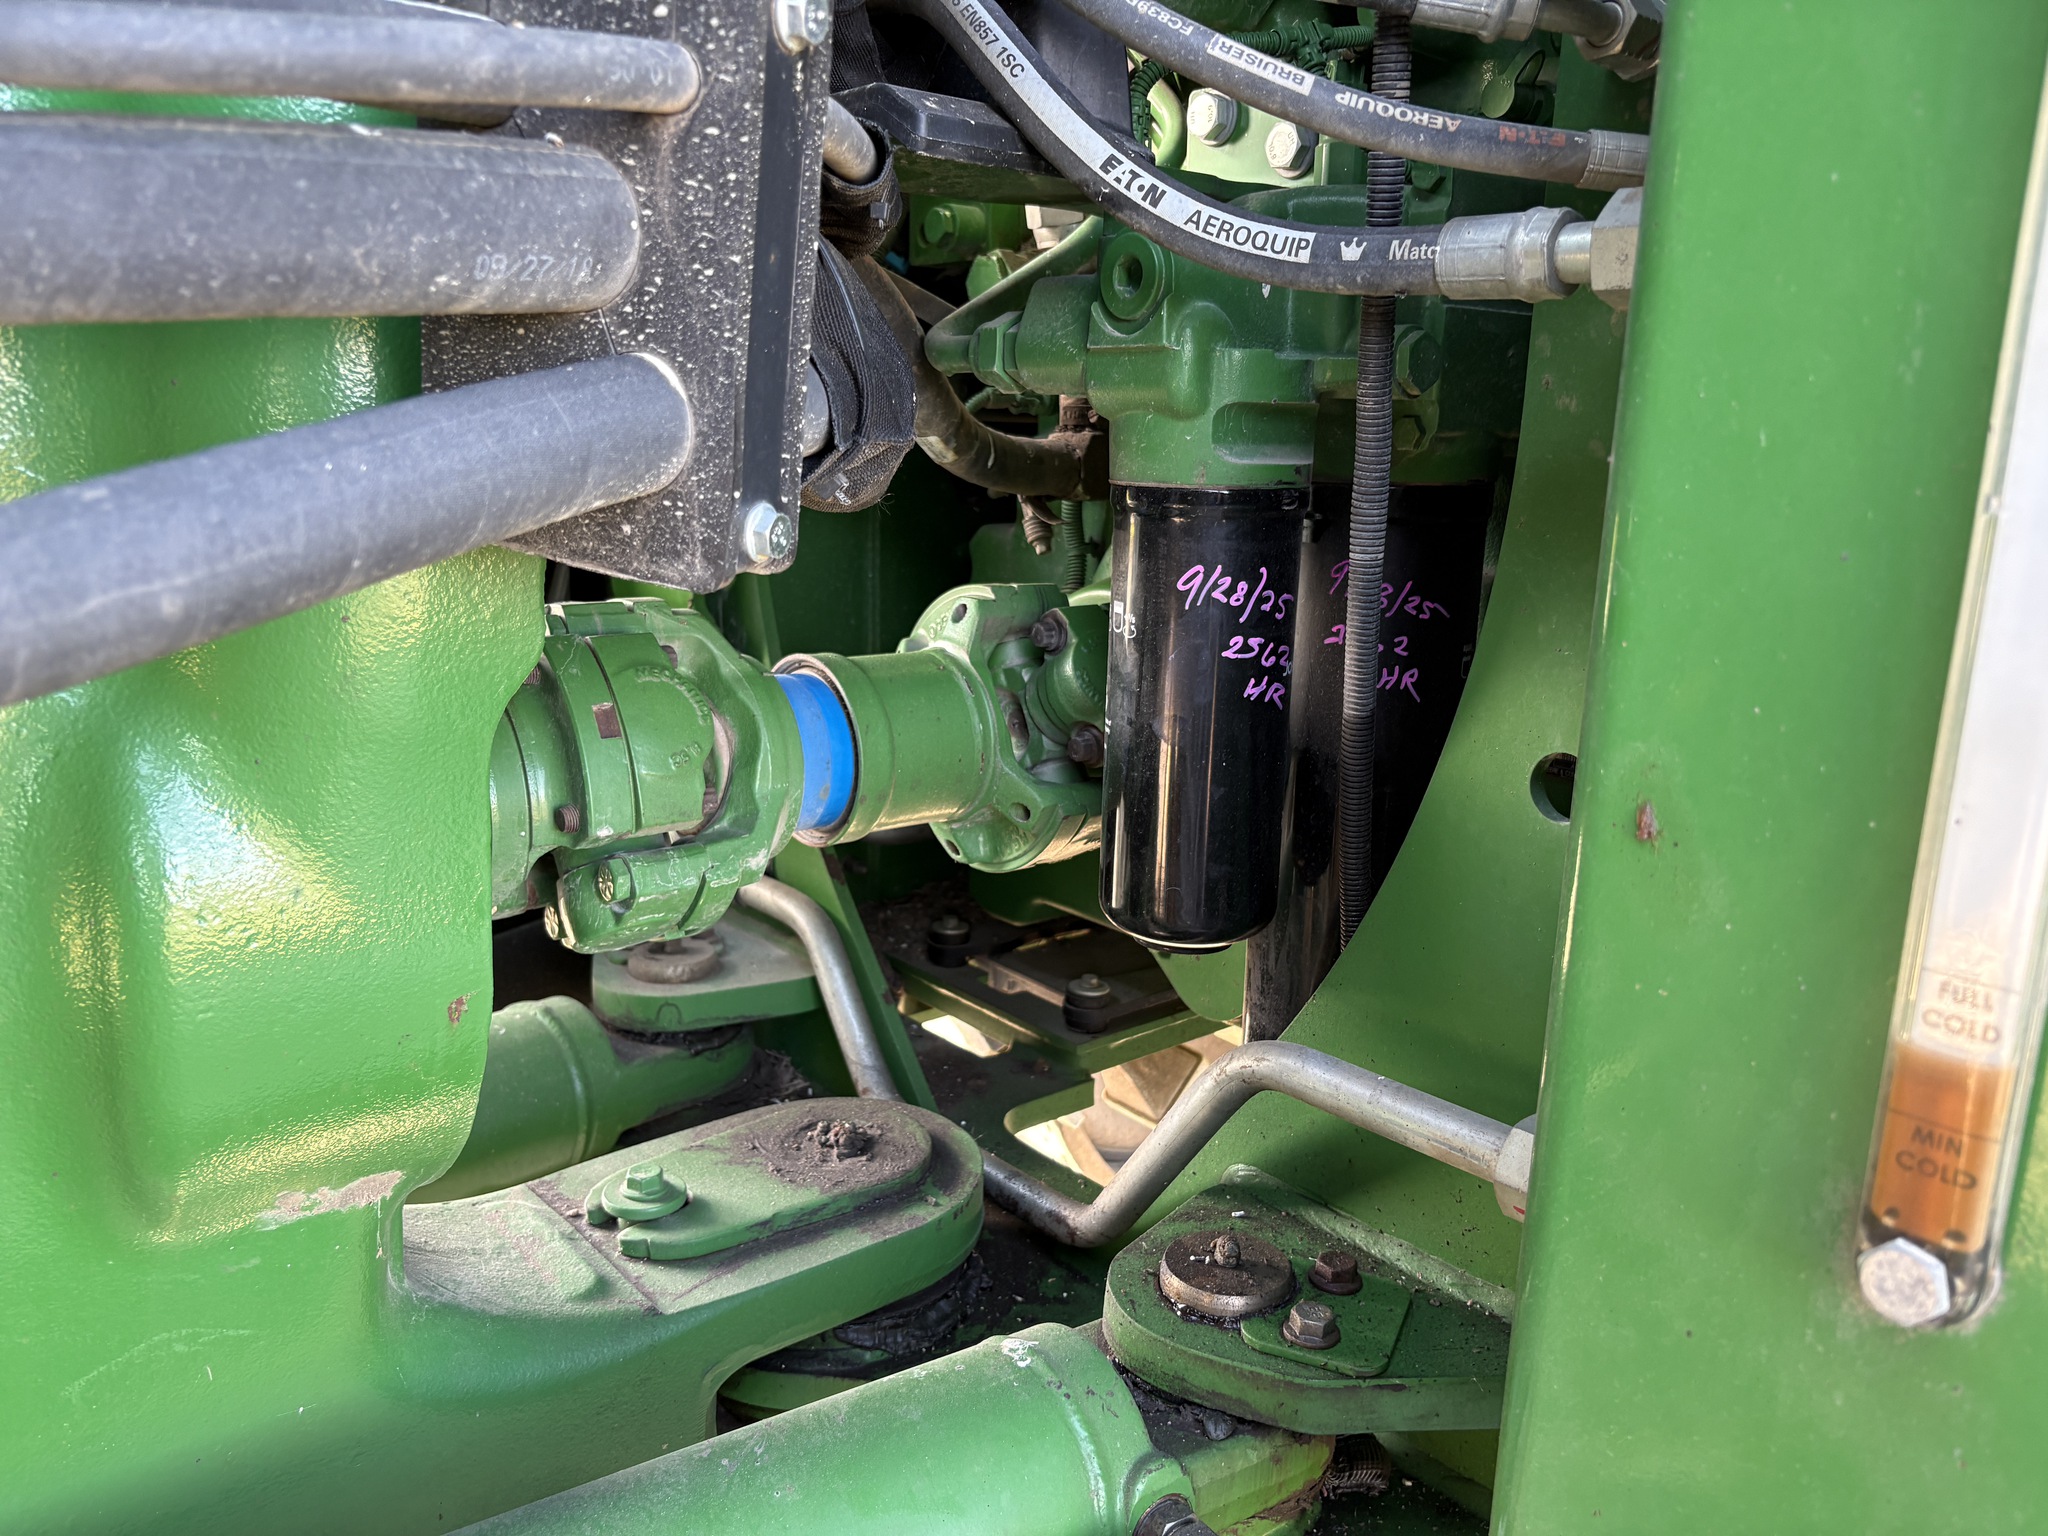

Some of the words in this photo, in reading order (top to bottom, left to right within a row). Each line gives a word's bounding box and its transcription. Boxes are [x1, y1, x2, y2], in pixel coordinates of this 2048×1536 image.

[960, 3, 1000, 45] EN857
[996, 46, 1025, 78] 1SC
[1218, 42, 1306, 84] BRUISER
[1335, 90, 1462, 132] AEROQUIP
[1099, 153, 1167, 209] EATON
[1184, 210, 1311, 259] AEROQUIP
[1177, 565, 1294, 623] 9/28/25
[1243, 676, 1285, 709] HR
[1376, 666, 1420, 702] HR
[1921, 1008, 2002, 1044] COLD
[1912, 1125, 1964, 1157] MIN
[1895, 1149, 1978, 1190] COLD
